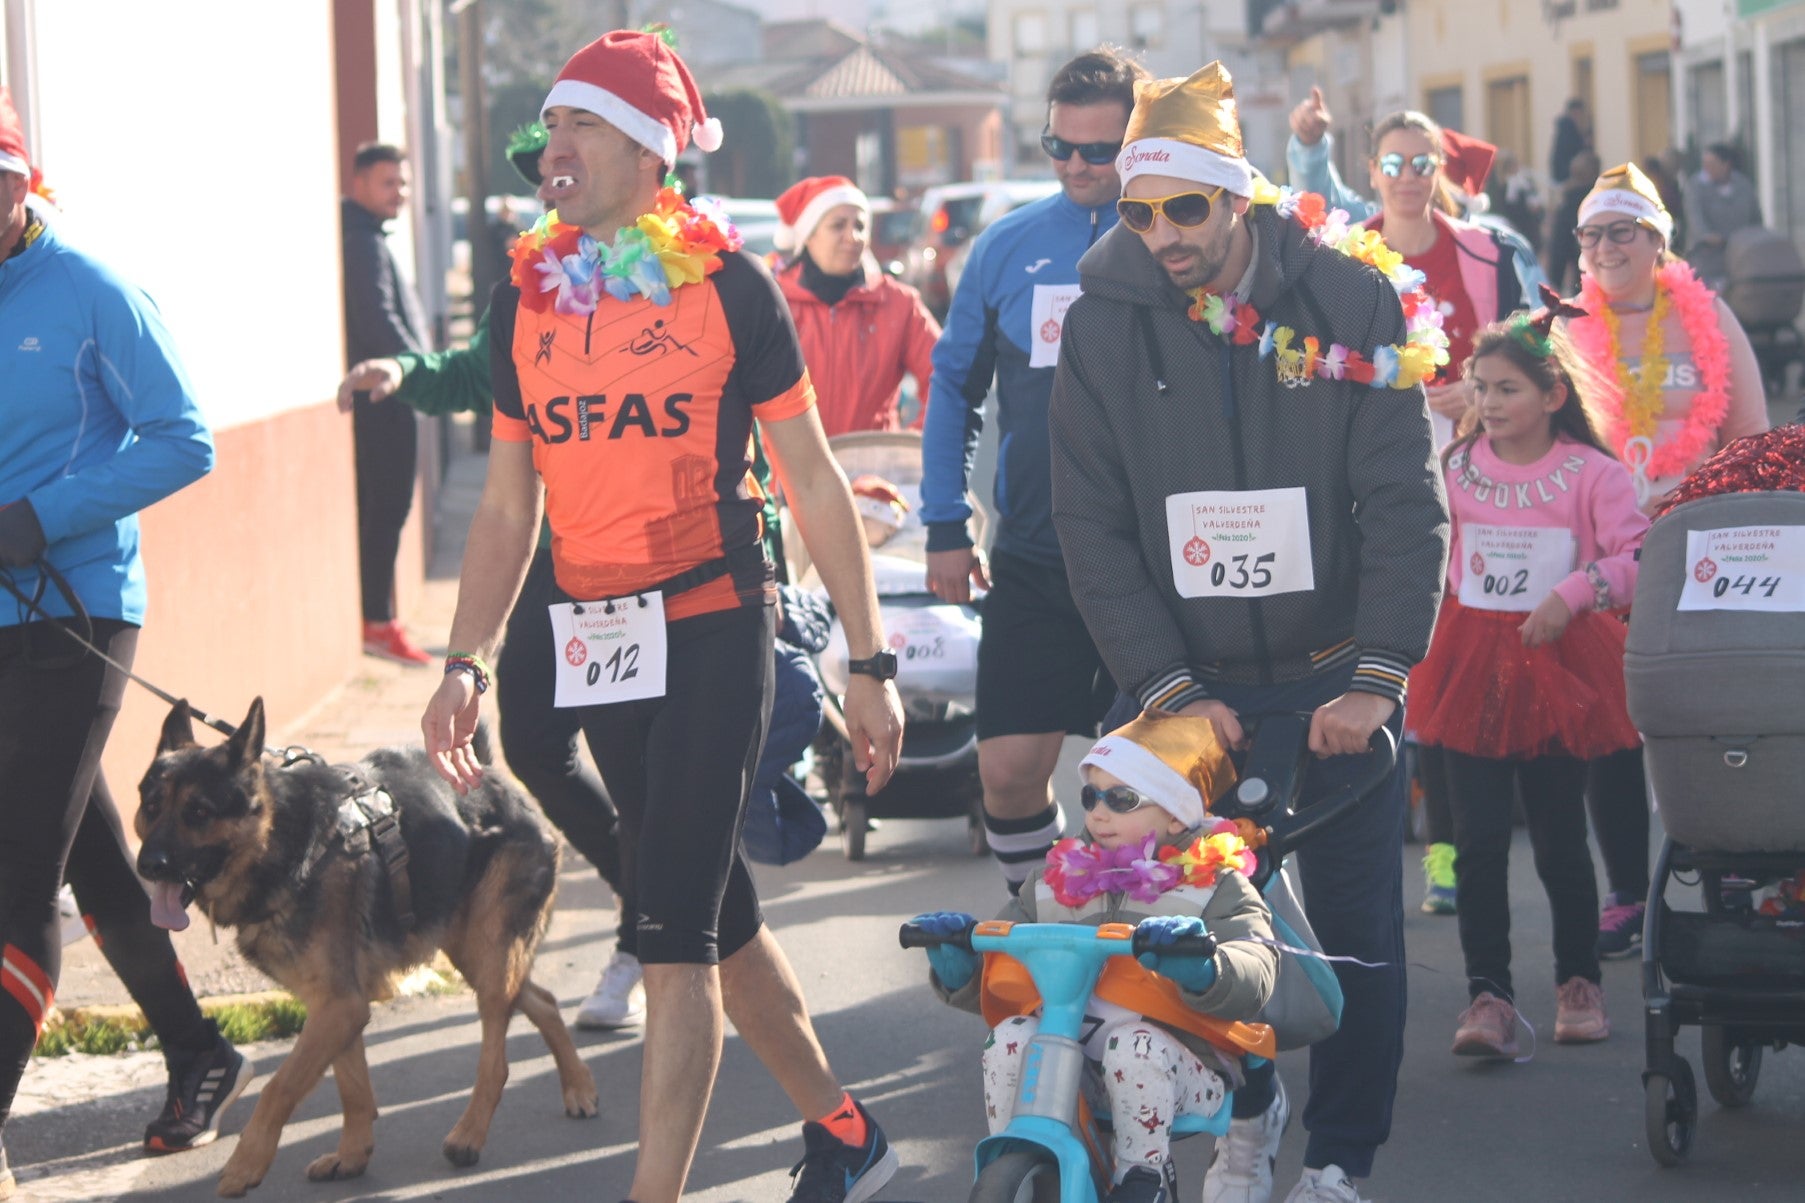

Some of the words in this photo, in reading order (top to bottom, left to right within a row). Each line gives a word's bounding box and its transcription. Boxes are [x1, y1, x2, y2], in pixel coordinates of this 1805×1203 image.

[1124, 145, 1171, 172] Sonata
[526, 392, 694, 445] ASFAS
[578, 400, 589, 439] Badajoz
[1448, 451, 1586, 509] BROOKLYN
[1195, 505, 1215, 515] SAN
[1218, 504, 1265, 515] SILVESTRE
[1202, 518, 1261, 529] VALVERDEÑA
[1711, 531, 1729, 540] SAN
[1733, 529, 1781, 538] SILVESTRE
[1210, 552, 1276, 589] 035
[1483, 568, 1529, 596] 002
[1713, 574, 1781, 598] 044
[586, 643, 640, 687] 012
